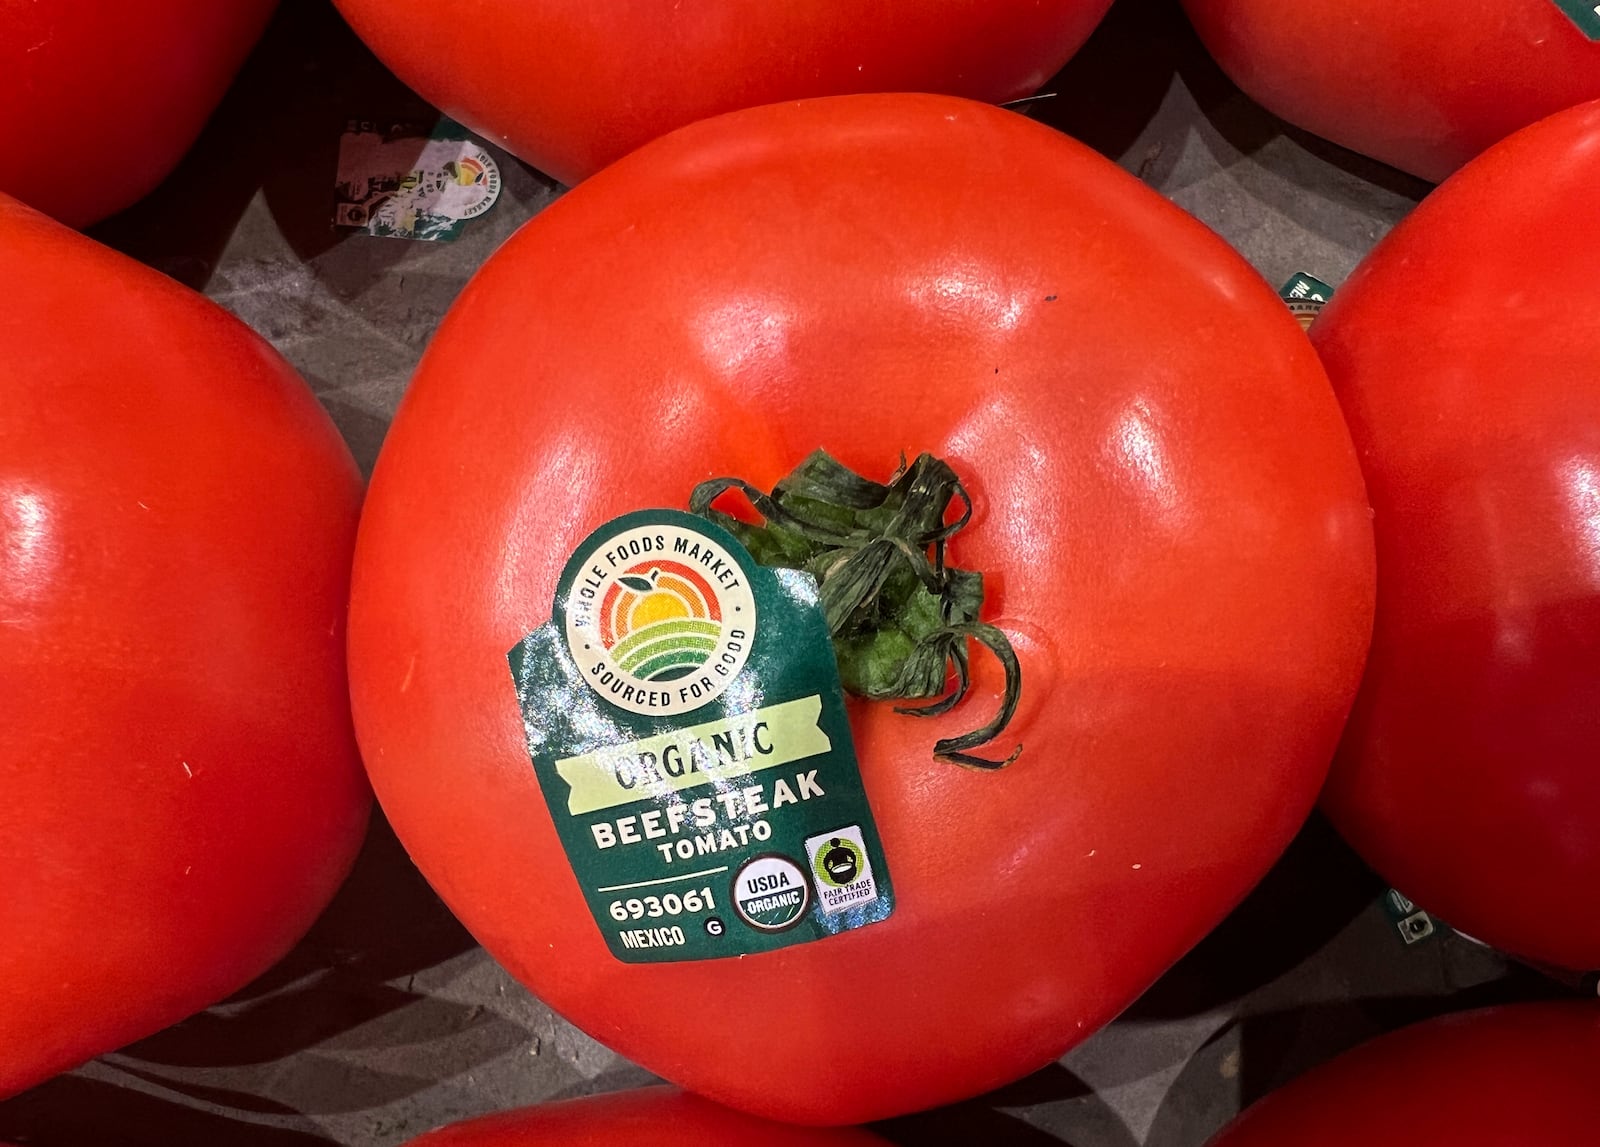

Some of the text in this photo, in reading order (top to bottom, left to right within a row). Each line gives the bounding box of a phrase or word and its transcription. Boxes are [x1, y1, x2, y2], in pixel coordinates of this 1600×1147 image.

[575, 535, 739, 627] WHOLE FOODS MARKET
[591, 628, 747, 707] SOURCED FOR GOOD
[614, 721, 775, 790] ORGANIC
[591, 769, 825, 850] BEEFSTEAK
[657, 818, 772, 864] TOMATO
[746, 890, 801, 915] ORGANIC
[747, 871, 790, 894] USDA
[823, 878, 872, 899] FAIR TRADE
[609, 886, 716, 922] 693061
[620, 924, 686, 950] MEXICO
